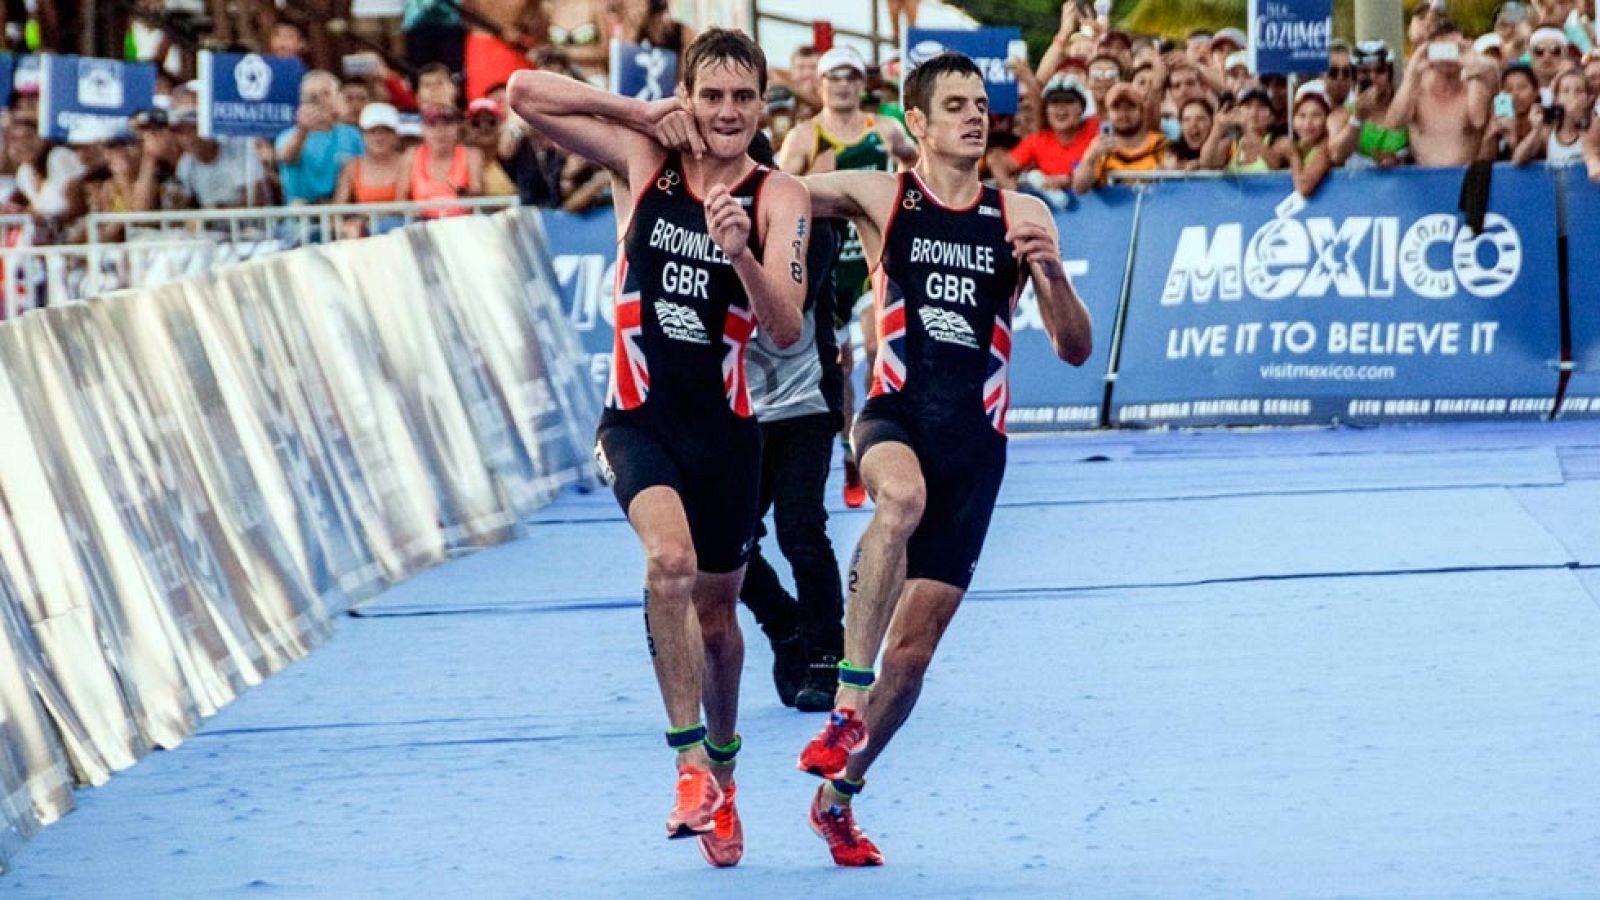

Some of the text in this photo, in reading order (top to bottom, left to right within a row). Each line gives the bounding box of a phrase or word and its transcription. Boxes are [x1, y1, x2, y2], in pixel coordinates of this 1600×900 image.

[911, 237, 995, 275] BROWNLEE
[662, 260, 710, 299] GBR
[926, 272, 977, 307] GBR
[1167, 321, 1499, 359] LIVE IT TO BELIEVE IT
[1259, 362, 1395, 380] visitmexico.com
[1192, 399, 1260, 416] TRIATHLON
[1263, 399, 1312, 415] SERIES
[1434, 399, 1506, 413] TRIATHLON
